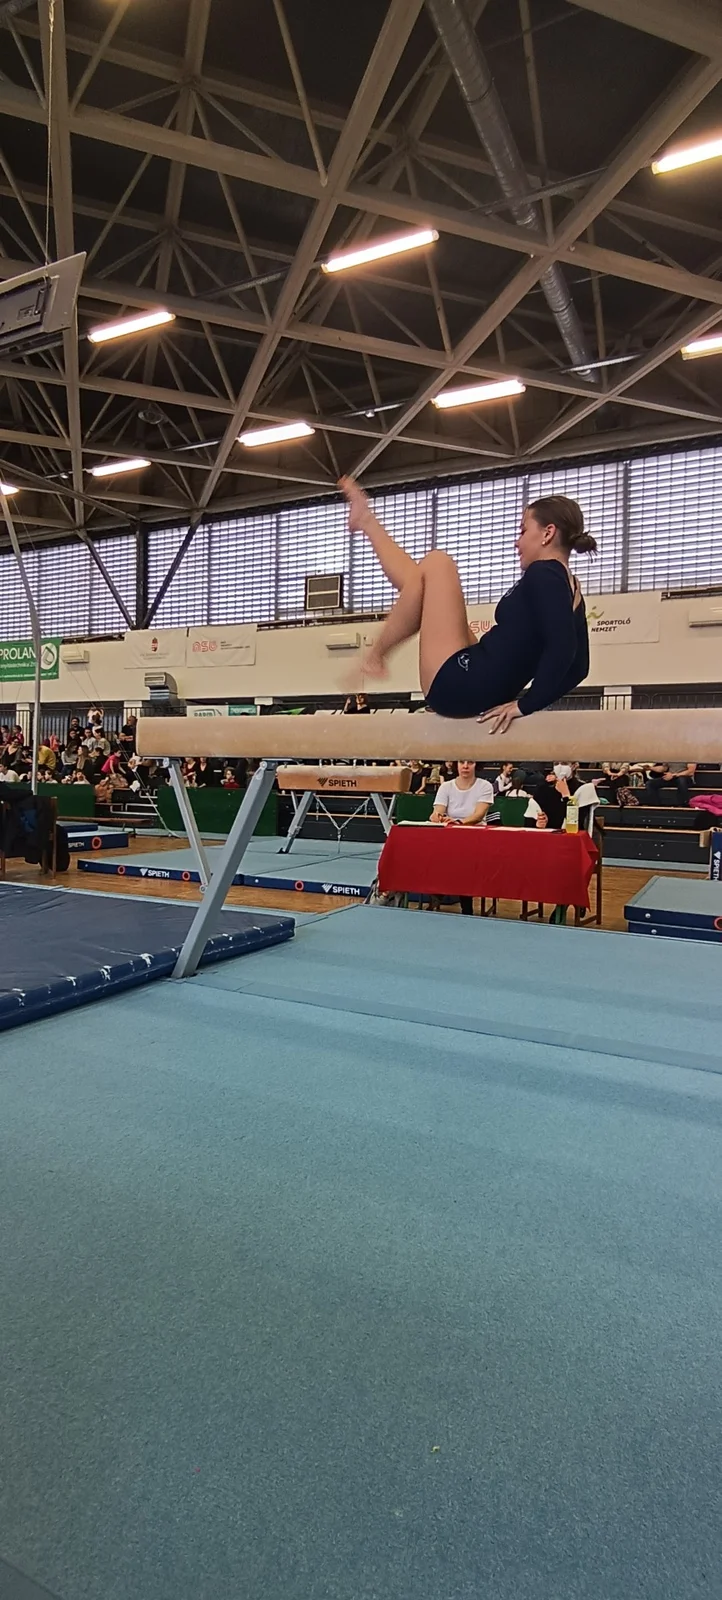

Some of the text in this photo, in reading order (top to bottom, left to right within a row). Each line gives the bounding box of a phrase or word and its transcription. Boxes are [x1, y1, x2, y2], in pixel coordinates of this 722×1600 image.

[597, 617, 631, 626] SPORTOLÓ
[328, 779, 357, 788] SPIETH
[147, 869, 170, 878] SPIETH
[332, 885, 360, 896] SPIETH
